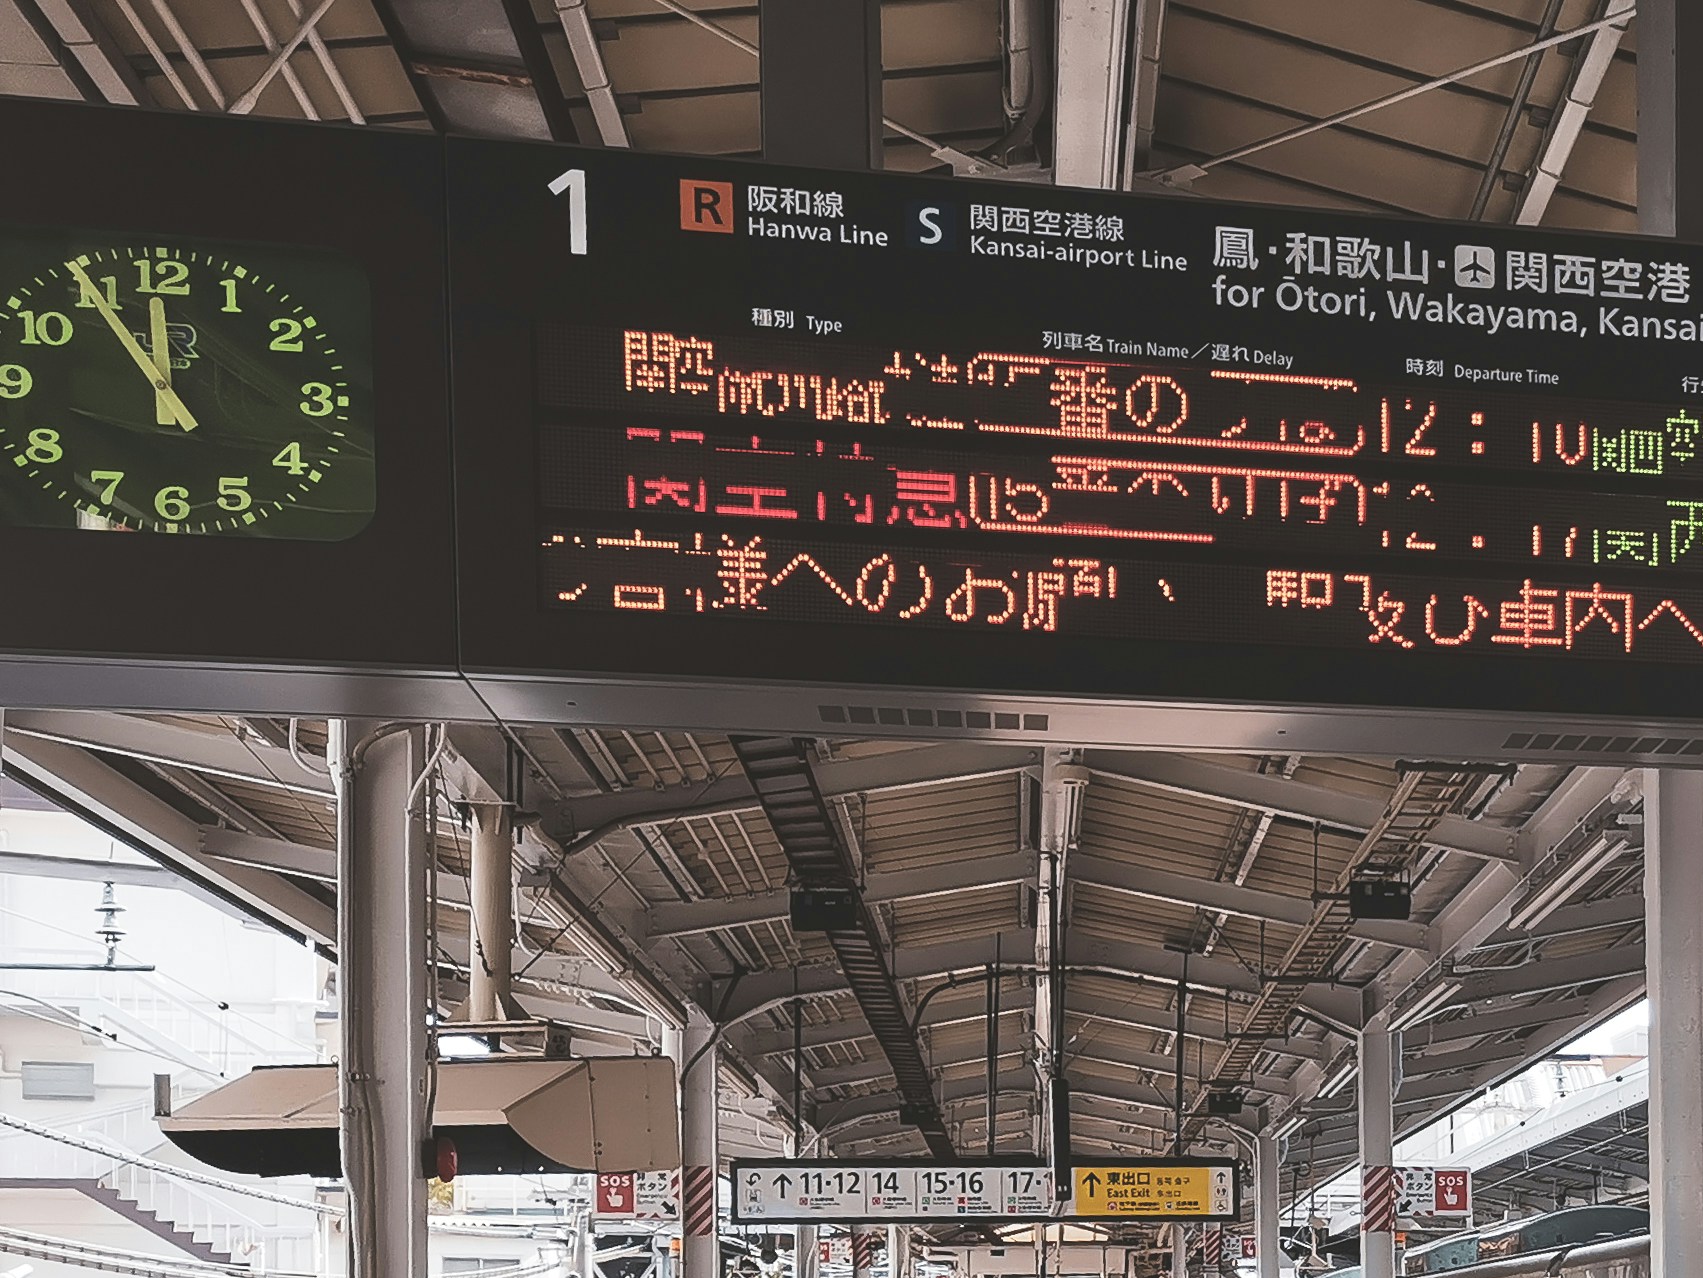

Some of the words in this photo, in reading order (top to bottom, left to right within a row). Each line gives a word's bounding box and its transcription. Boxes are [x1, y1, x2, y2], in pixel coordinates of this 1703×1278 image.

[548, 169, 587, 255] 1
[692, 187, 722, 224] R
[748, 186, 844, 218] 阪和線
[749, 217, 831, 241] Hanwa
[840, 225, 888, 246] Line
[919, 207, 942, 244] S
[971, 205, 1124, 244] 関西空港線
[971, 235, 1134, 267] Kansai-airport
[1143, 250, 1187, 271] Line
[133, 260, 190, 295] 12
[1507, 251, 1690, 303] 関西空港
[219, 279, 242, 312] 1
[1212, 275, 1264, 308] for
[1276, 276, 1375, 321] Ōtori,
[1387, 291, 1586, 337] Wakayama,
[17, 311, 73, 345] 10
[752, 308, 794, 328] 種別
[806, 316, 842, 335] Type
[269, 318, 303, 352] 2
[1042, 331, 1103, 352] 列車名
[1107, 339, 1142, 354] Train
[1147, 342, 1188, 358] Name
[1212, 344, 1249, 361] 遅れ
[1254, 350, 1293, 369] Delay
[1406, 359, 1443, 377] 時刻
[0, 364, 33, 399] 9
[1455, 365, 1522, 382] Departure
[1526, 370, 1559, 384] Time
[300, 382, 333, 416] 3
[26, 428, 63, 463] 8
[272, 442, 308, 475] 4
[91, 470, 124, 505] 7
[154, 486, 190, 520] 6
[217, 477, 251, 511] 5
[600, 1175, 631, 1187] SOS
[872, 1172, 899, 1194] 14
[1106, 1172, 1150, 1185] 東出口
[1107, 1188, 1128, 1198] East
[1131, 1188, 1150, 1198] Exit
[1438, 1176, 1464, 1187] SOS
